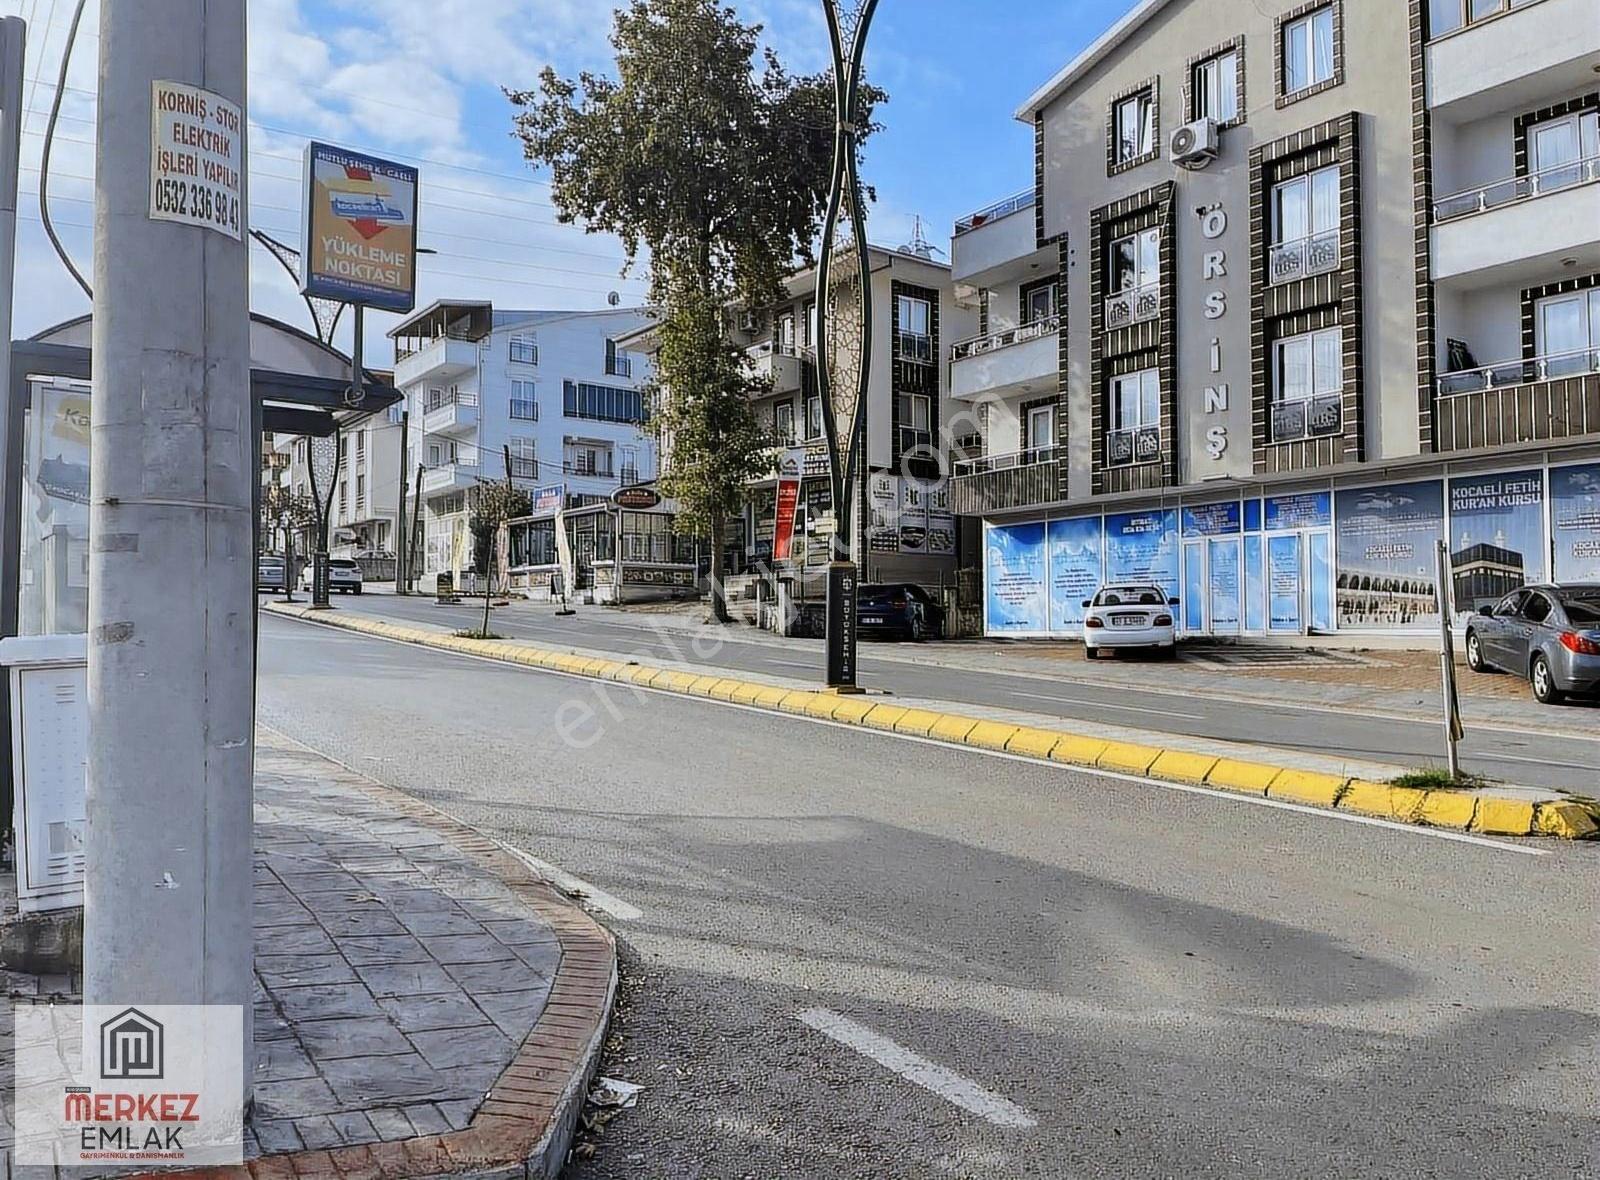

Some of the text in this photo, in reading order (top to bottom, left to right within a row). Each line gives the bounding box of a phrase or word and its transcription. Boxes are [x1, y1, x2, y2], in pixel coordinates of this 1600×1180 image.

[158, 89, 207, 123] KORNİŞ
[173, 122, 231, 158] ELEKTRİK
[157, 146, 239, 192] İŞLERİ YAPILIR
[155, 178, 188, 215] 0532
[190, 183, 213, 221] 336
[215, 190, 229, 226] 98
[321, 235, 406, 268] YÜKLEME
[324, 256, 401, 286] NOKTASI
[1452, 492, 1541, 511] KUR'AN KURSU
[1505, 478, 1541, 494] FETİH
